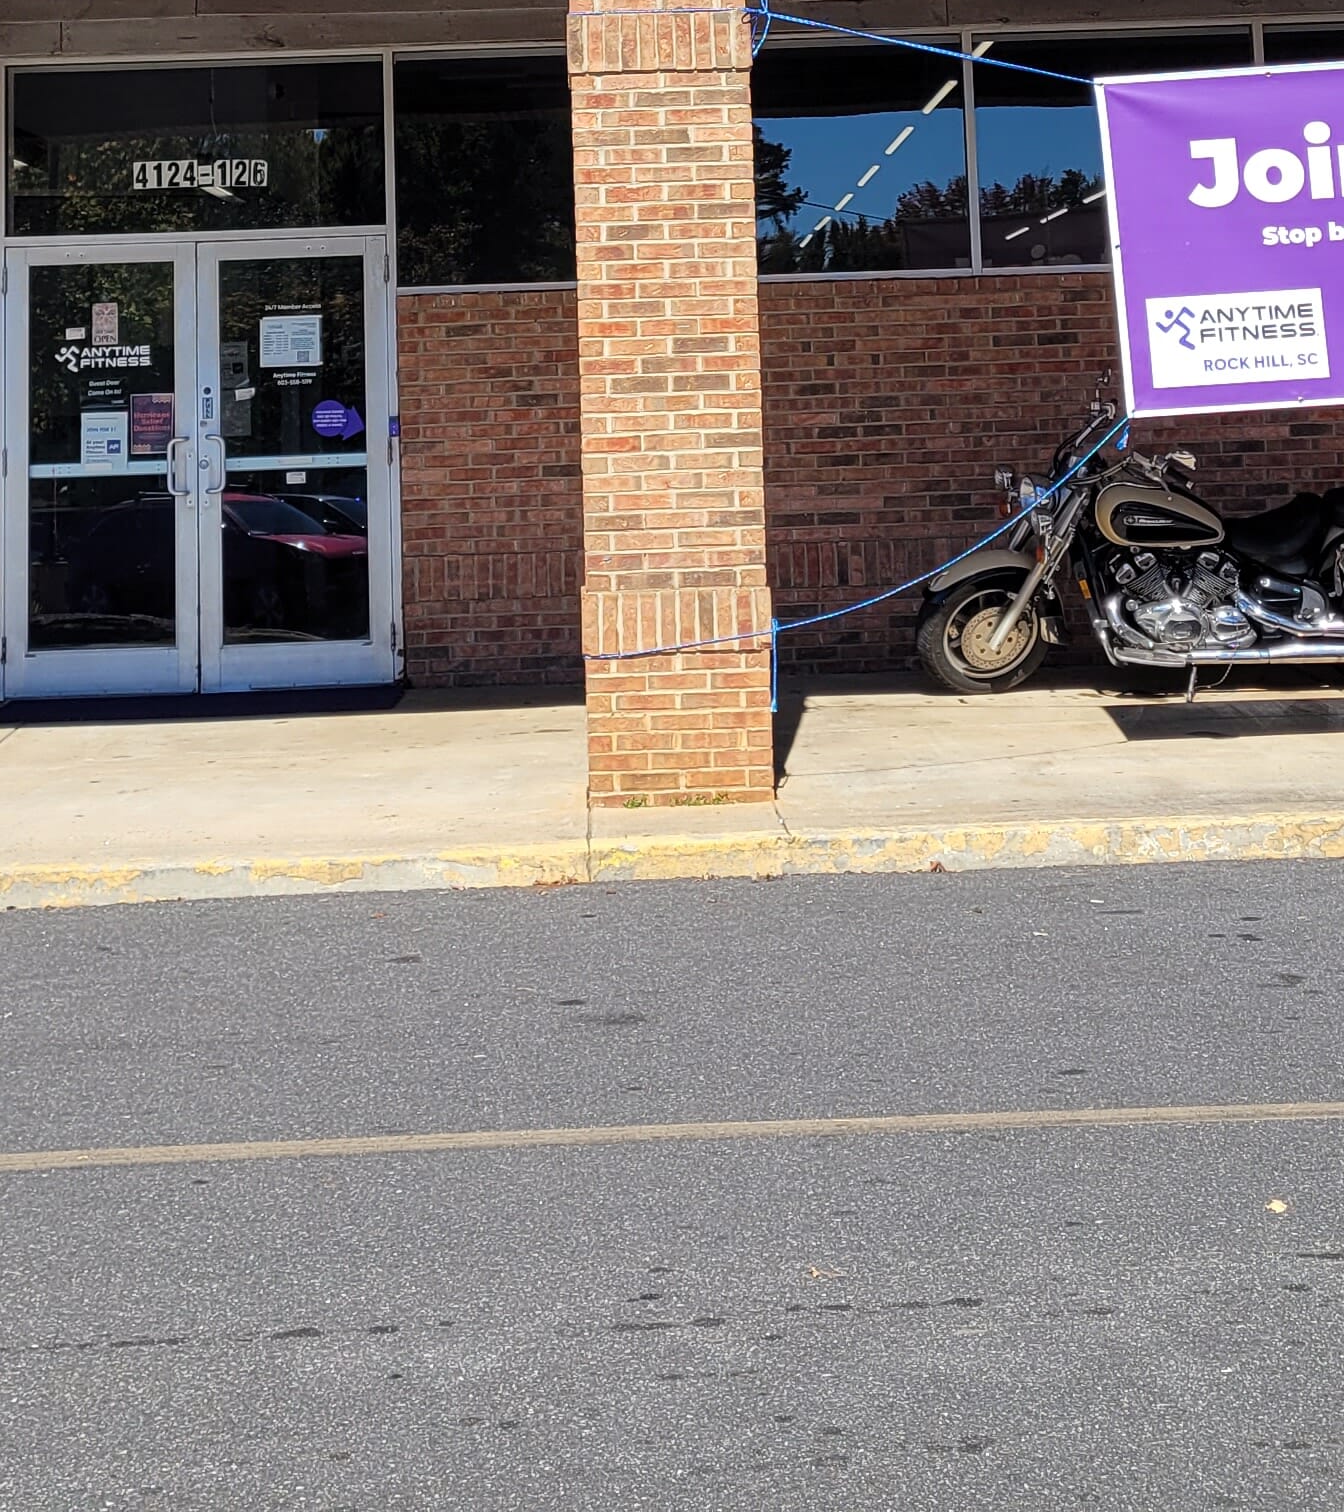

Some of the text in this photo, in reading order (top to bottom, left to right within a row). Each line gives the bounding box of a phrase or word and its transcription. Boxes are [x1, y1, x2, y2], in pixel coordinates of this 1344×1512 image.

[134, 160, 267, 188] 4124-126
[1262, 225, 1322, 247] Stop
[1200, 303, 1314, 324] ANYTIME
[1200, 322, 1316, 343] FITNESS
[80, 345, 151, 358] ANYTIME
[1204, 352, 1319, 371] ROCK HILL, SC
[79, 356, 151, 369] FITNESS
